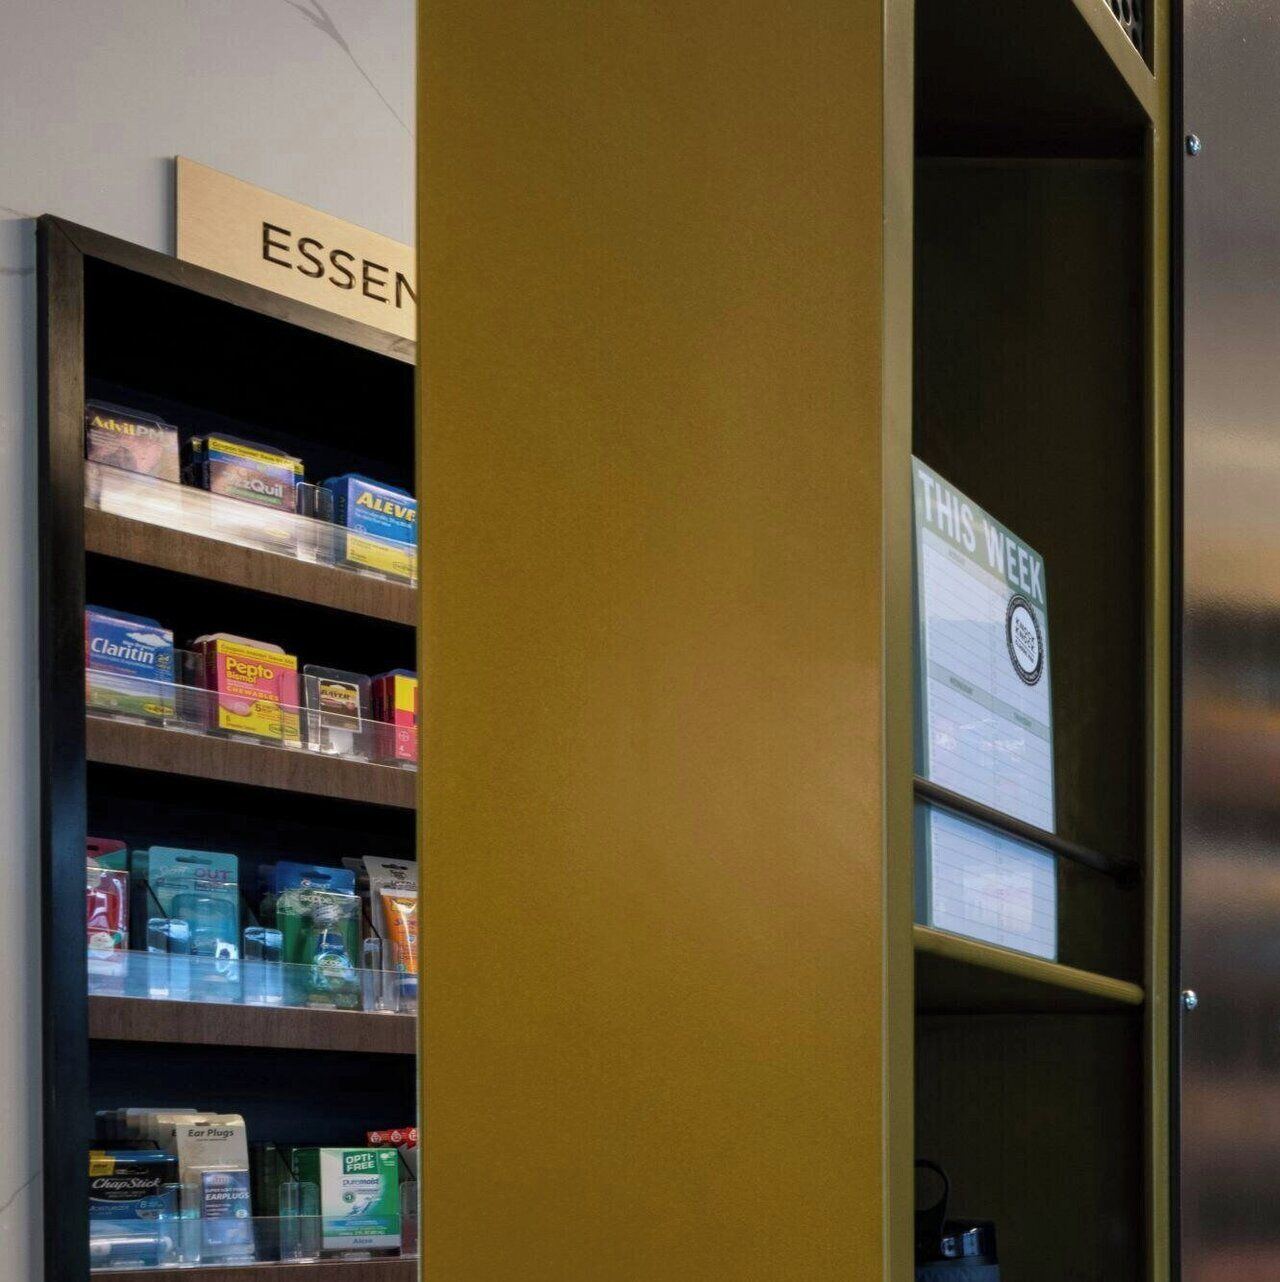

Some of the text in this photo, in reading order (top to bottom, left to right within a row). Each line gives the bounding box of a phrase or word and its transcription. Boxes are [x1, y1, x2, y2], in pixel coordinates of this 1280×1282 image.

[91, 415, 136, 436] Advil
[918, 470, 1044, 605] THIS WEEK
[90, 637, 155, 665] Claritin
[225, 656, 274, 681] Pepto
[188, 1127, 235, 1141] Ear Plugs
[346, 1161, 376, 1172] FREE
[91, 1176, 161, 1190] ChapStick
[205, 1191, 250, 1201] EARPLUGS
